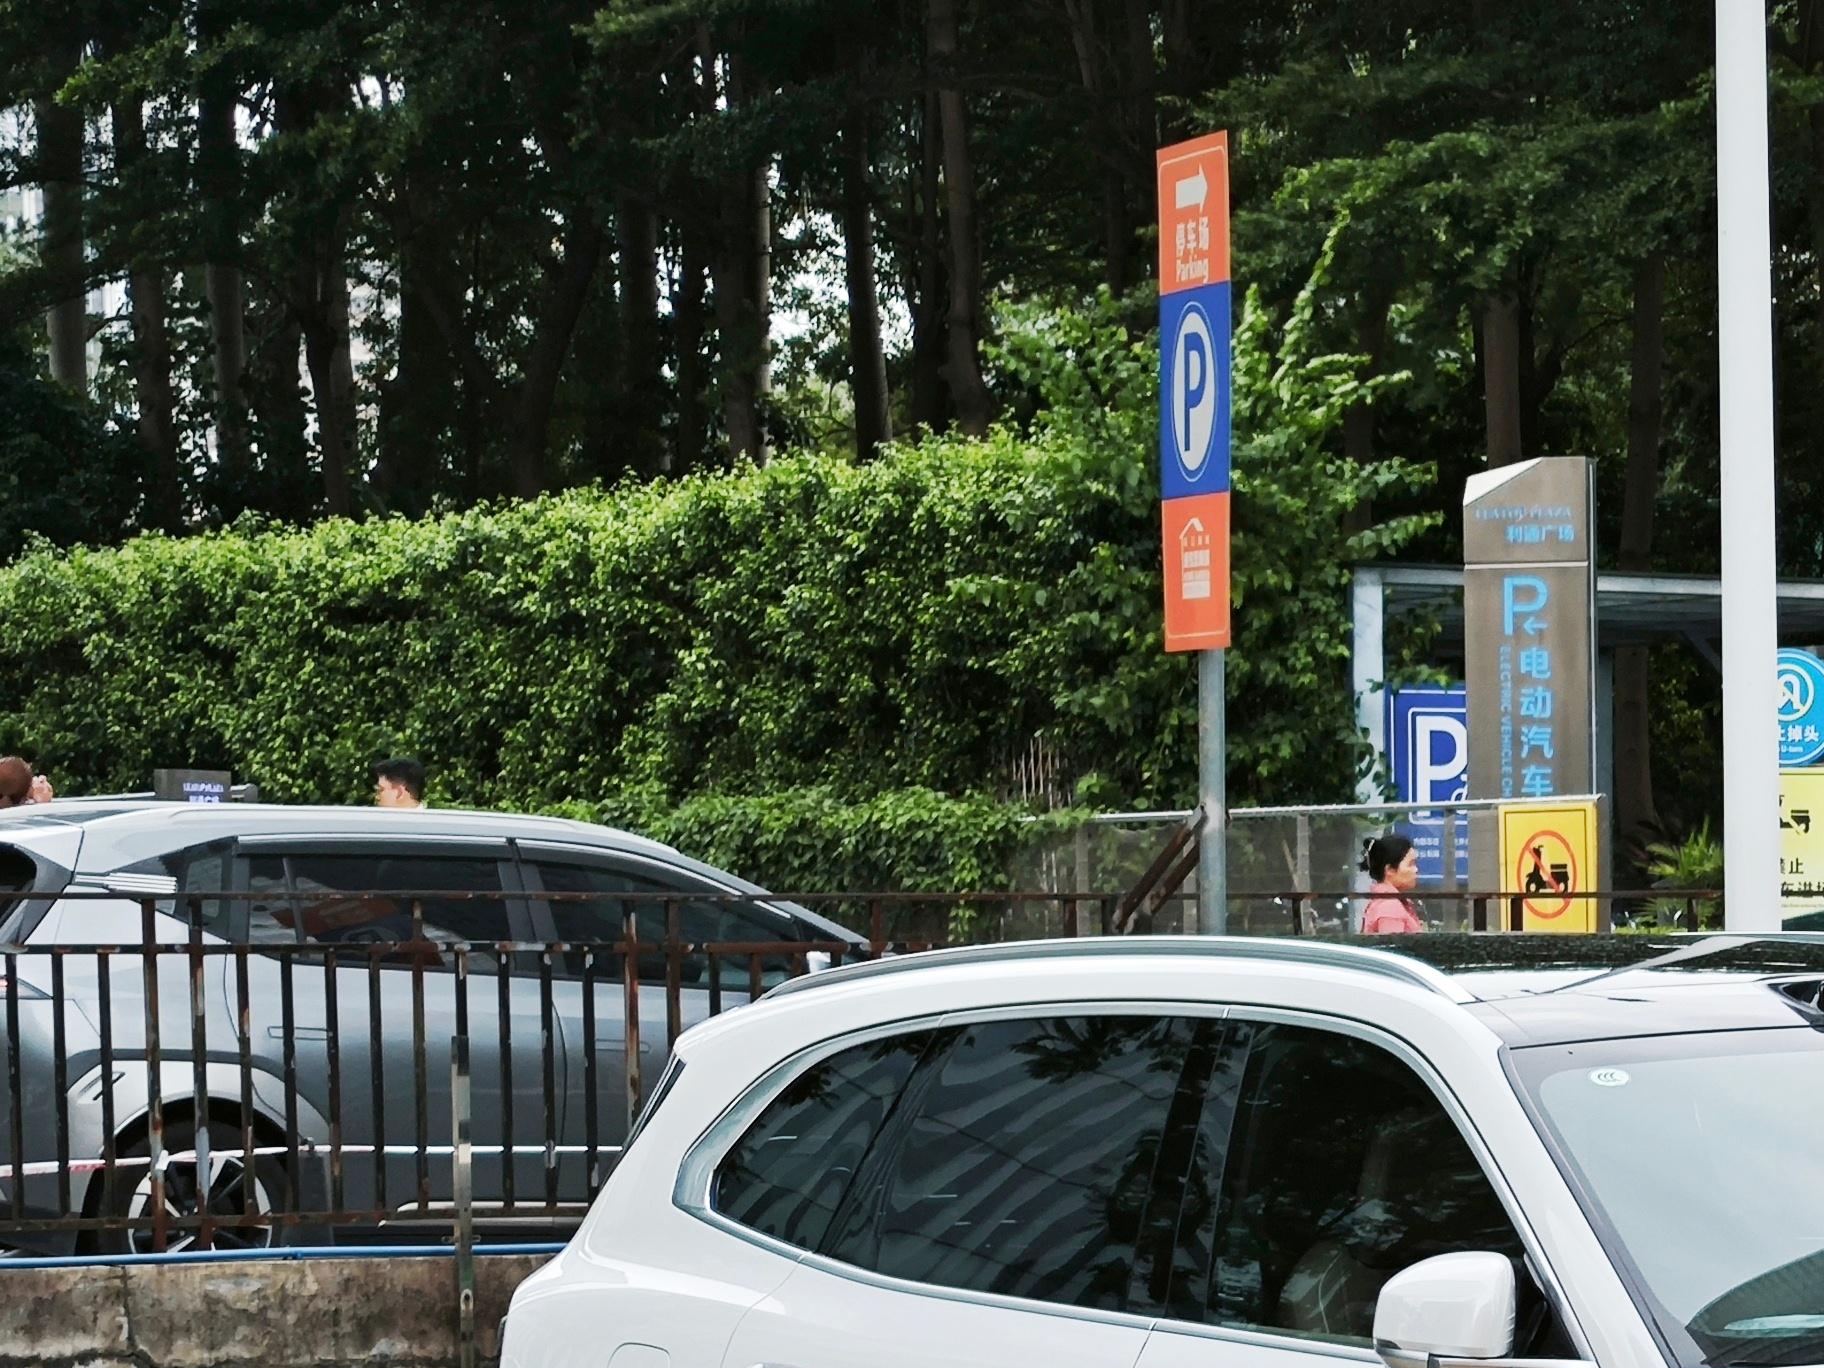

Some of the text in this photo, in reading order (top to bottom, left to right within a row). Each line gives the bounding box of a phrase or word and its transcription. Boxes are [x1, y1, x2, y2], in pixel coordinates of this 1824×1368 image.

[1176, 216, 1209, 257] 停车场
[1176, 254, 1208, 284] Parking
[1184, 331, 1206, 451] P
[1503, 575, 1548, 636] P
[1500, 646, 1513, 713] ELECTRIC
[1500, 716, 1513, 775] VEHICLE
[1519, 647, 1554, 797] 电动汽车
[1416, 715, 1468, 817] P
